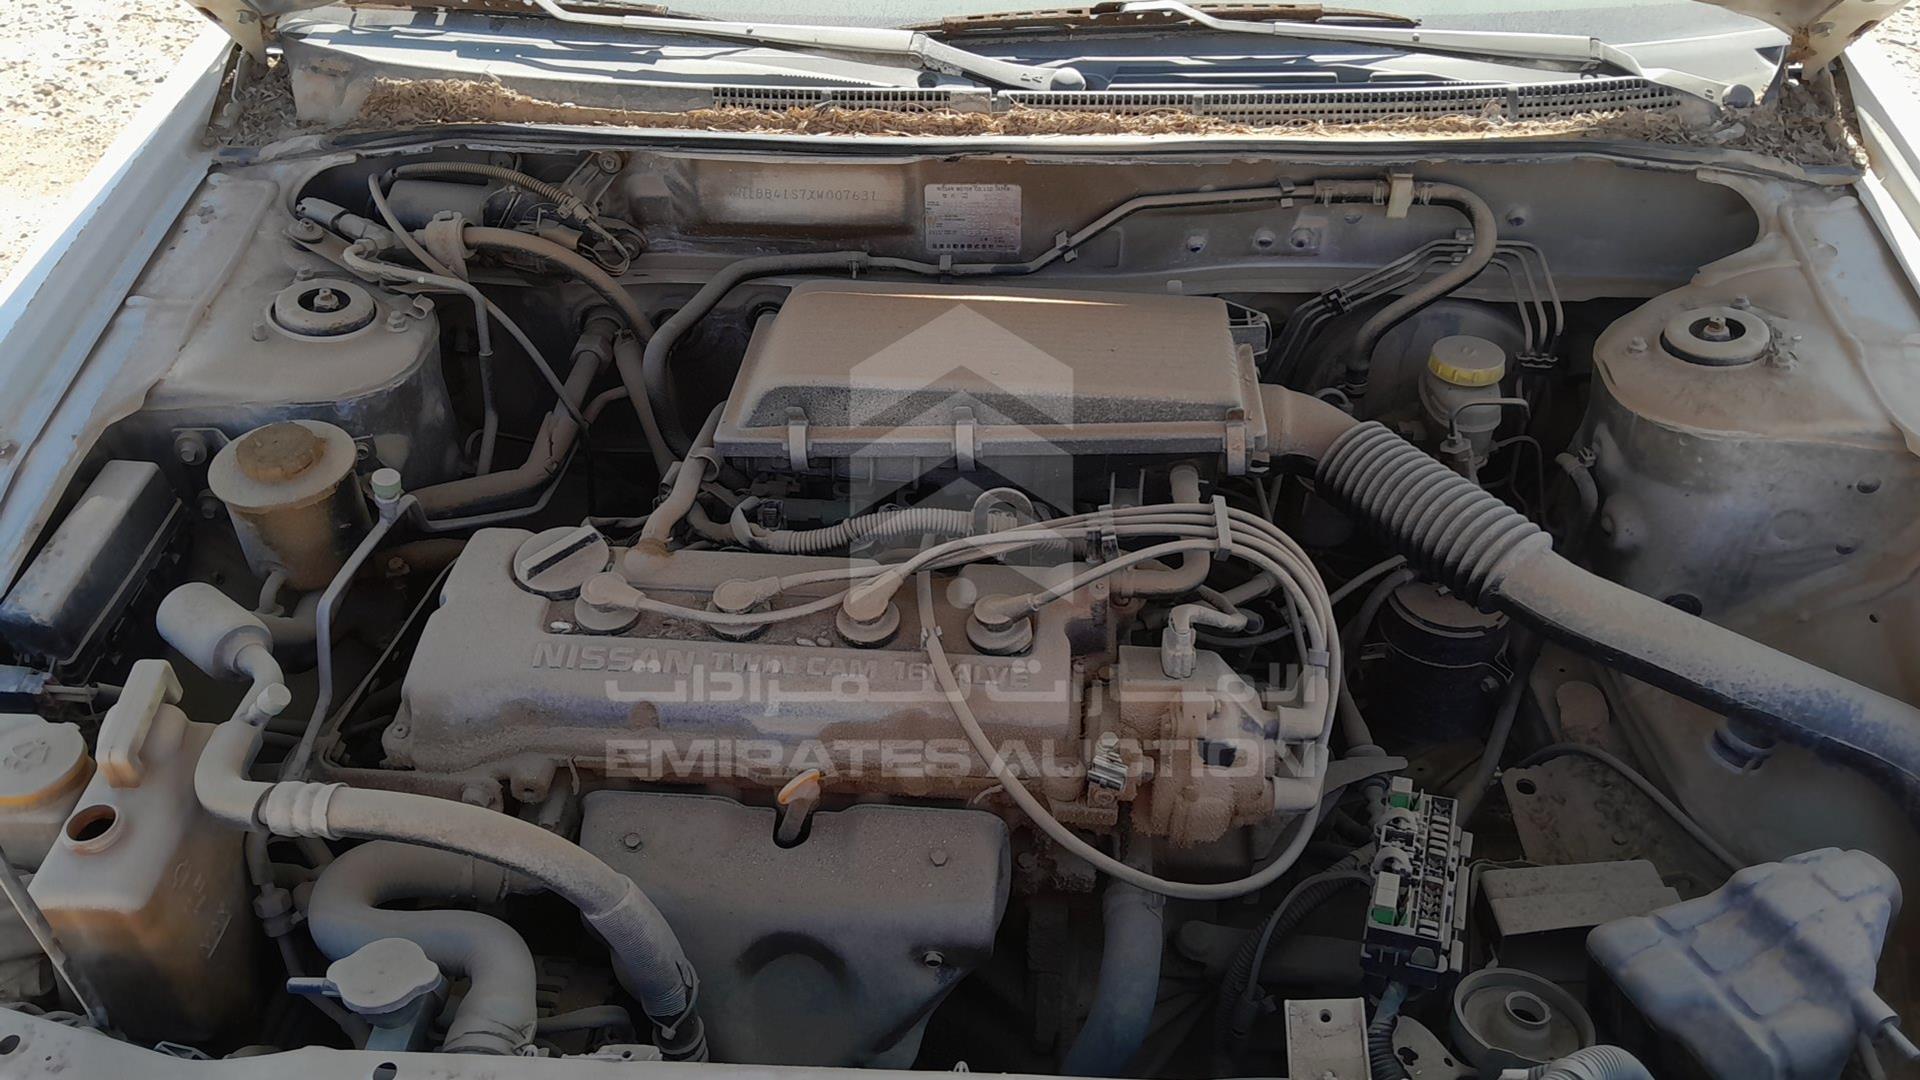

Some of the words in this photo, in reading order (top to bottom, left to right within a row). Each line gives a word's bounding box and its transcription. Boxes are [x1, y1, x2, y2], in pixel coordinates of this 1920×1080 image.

[531, 642, 697, 673] NISSAN
[711, 651, 796, 674] TWIN
[806, 656, 879, 679] CAM
